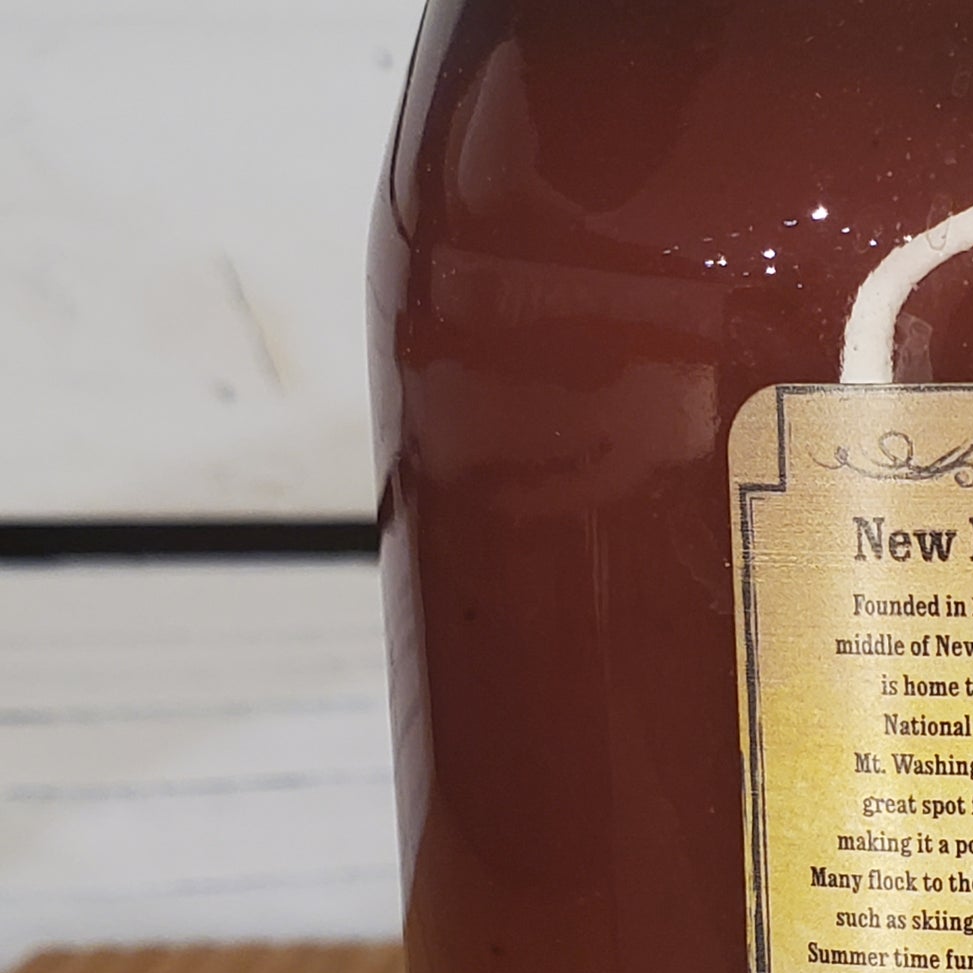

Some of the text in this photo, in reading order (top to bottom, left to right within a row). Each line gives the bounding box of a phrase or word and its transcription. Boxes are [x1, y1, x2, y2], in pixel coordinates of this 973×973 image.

[852, 516, 958, 563] New
[852, 593, 941, 618] Founded
[945, 594, 967, 618] in
[834, 633, 906, 657] middle
[910, 634, 931, 657] of
[880, 673, 899, 696] is
[902, 673, 960, 697] home
[883, 713, 972, 737] National
[862, 794, 918, 818] great
[921, 796, 967, 820] spot
[836, 829, 913, 858] making
[916, 832, 934, 854] it
[938, 838, 950, 855] a
[810, 865, 863, 894] Many
[867, 868, 919, 892] flock
[922, 873, 944, 893] to
[835, 906, 882, 929] such
[885, 914, 907, 931] as
